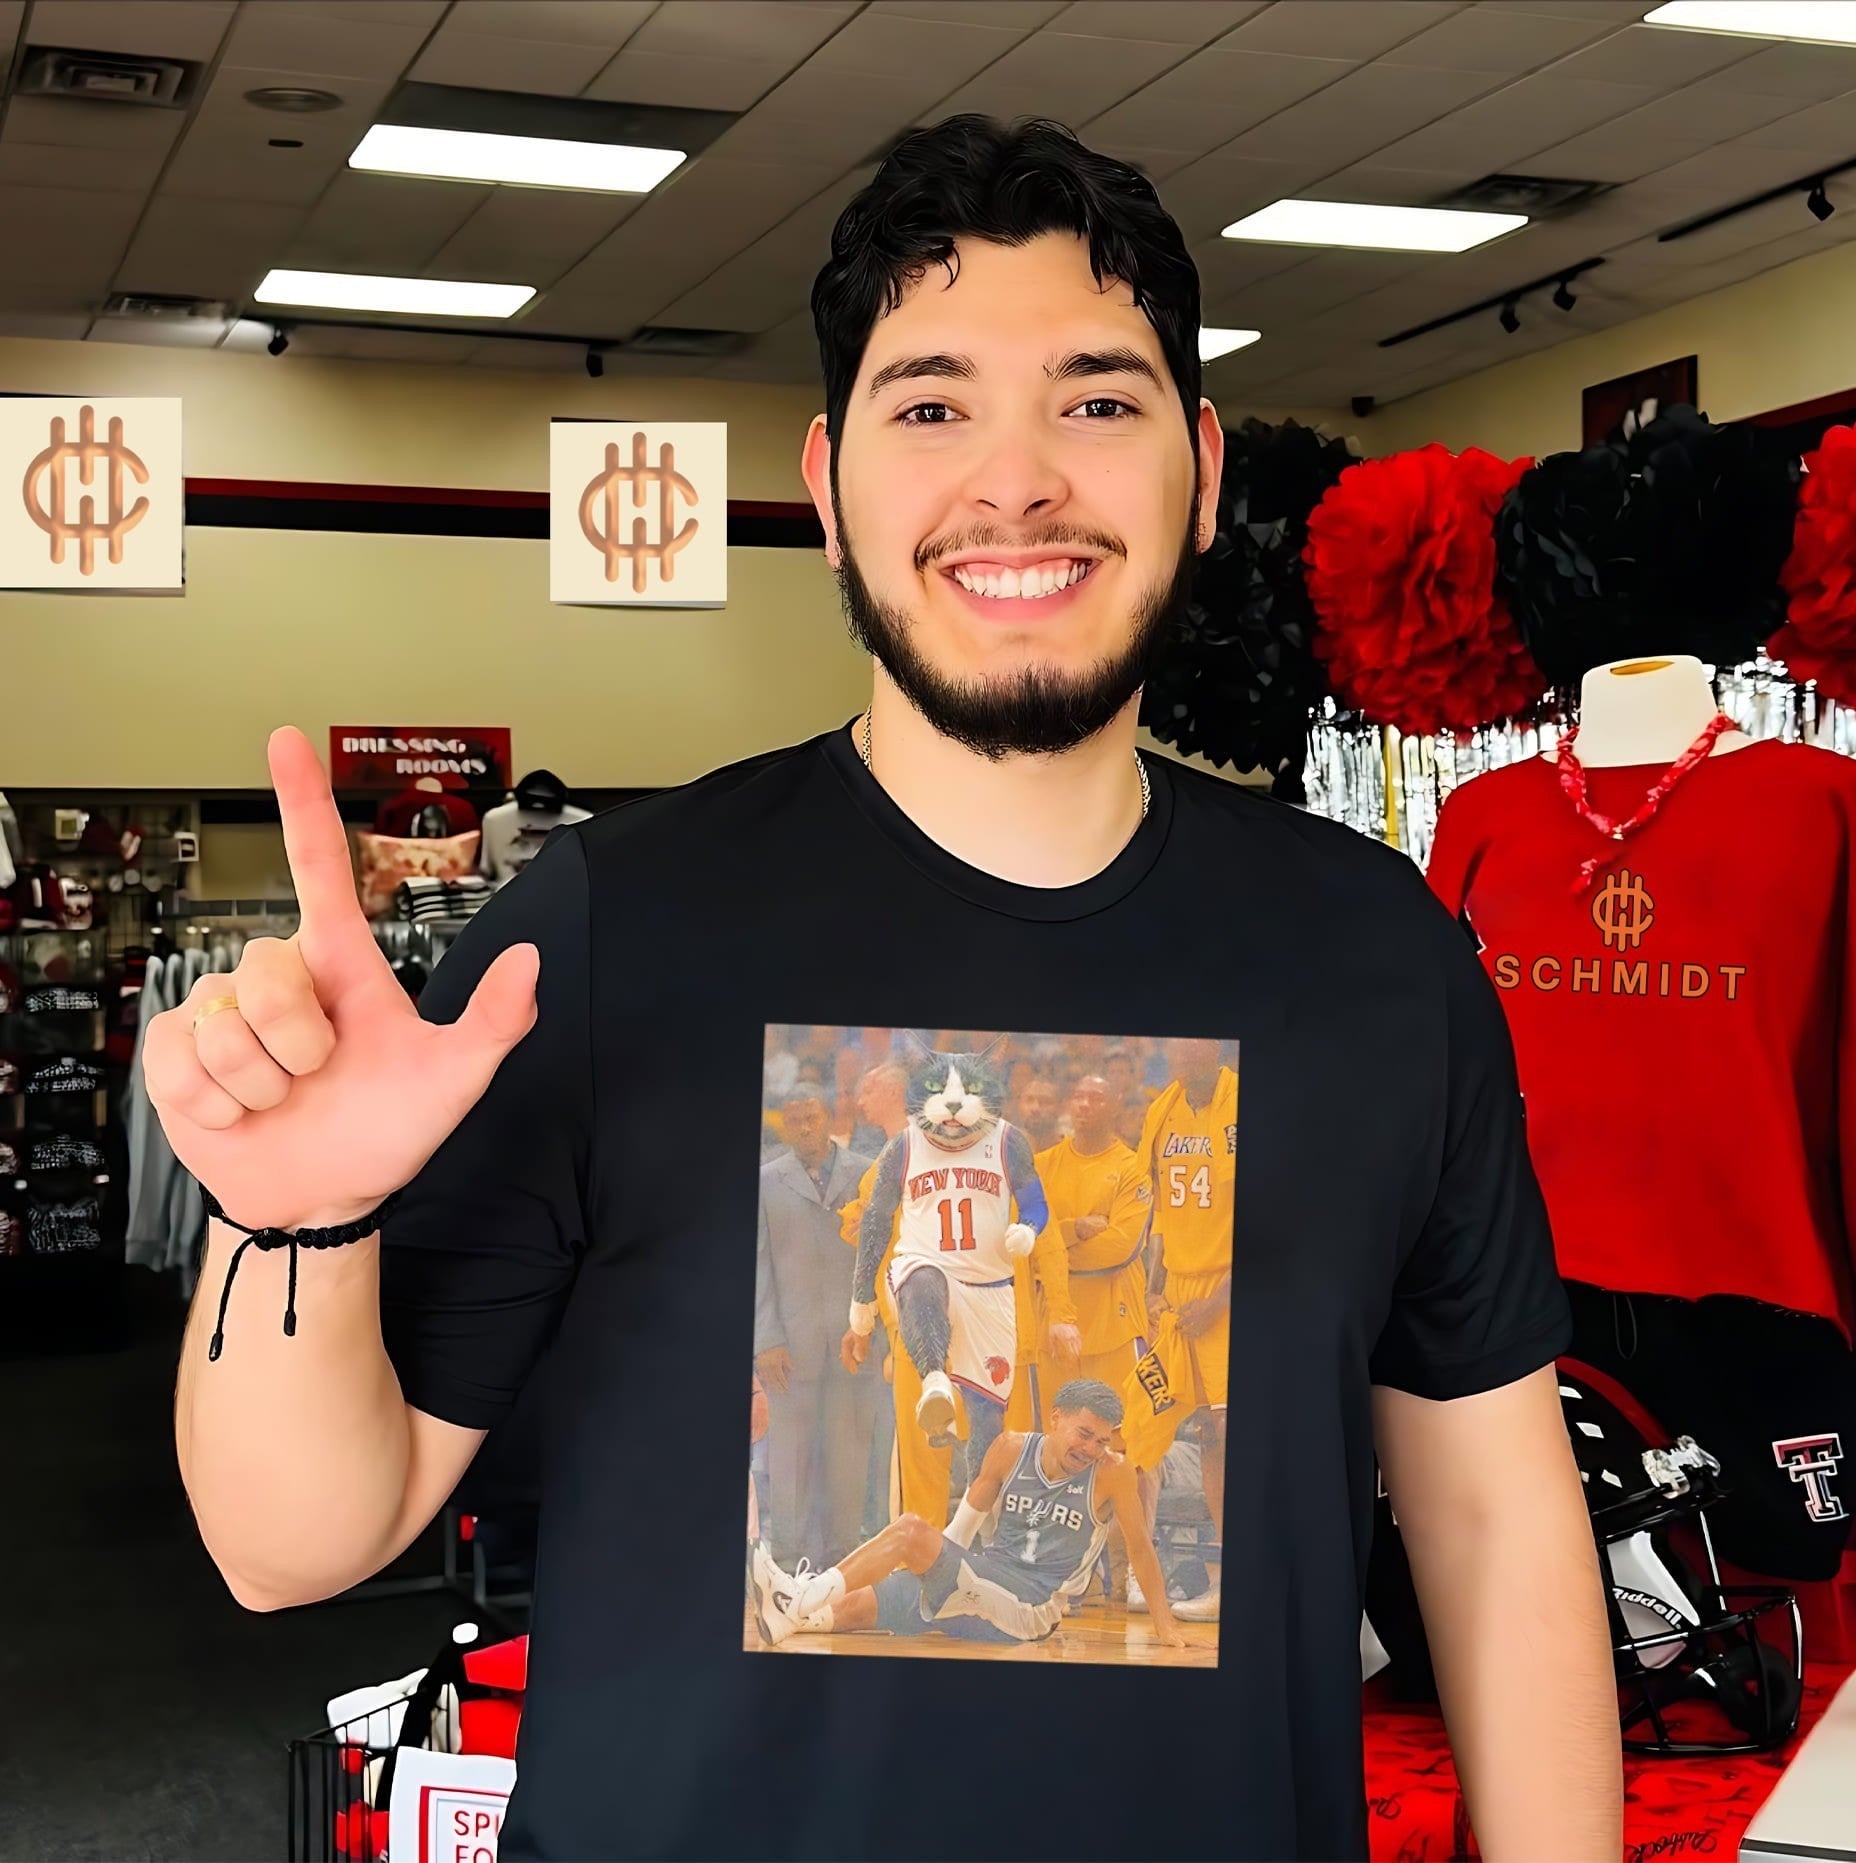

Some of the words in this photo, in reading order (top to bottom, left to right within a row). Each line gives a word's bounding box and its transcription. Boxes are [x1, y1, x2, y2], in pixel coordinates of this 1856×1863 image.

[342, 737, 467, 754] DRESSING
[396, 758, 487, 775] ROOMS
[1494, 954, 1747, 1000] SCHMIDT
[907, 1168, 950, 1202] NEW
[1169, 1164, 1211, 1209] 54
[937, 1198, 977, 1252] 11
[1005, 1493, 1084, 1532] SPURS
[1020, 1530, 1041, 1565] 1
